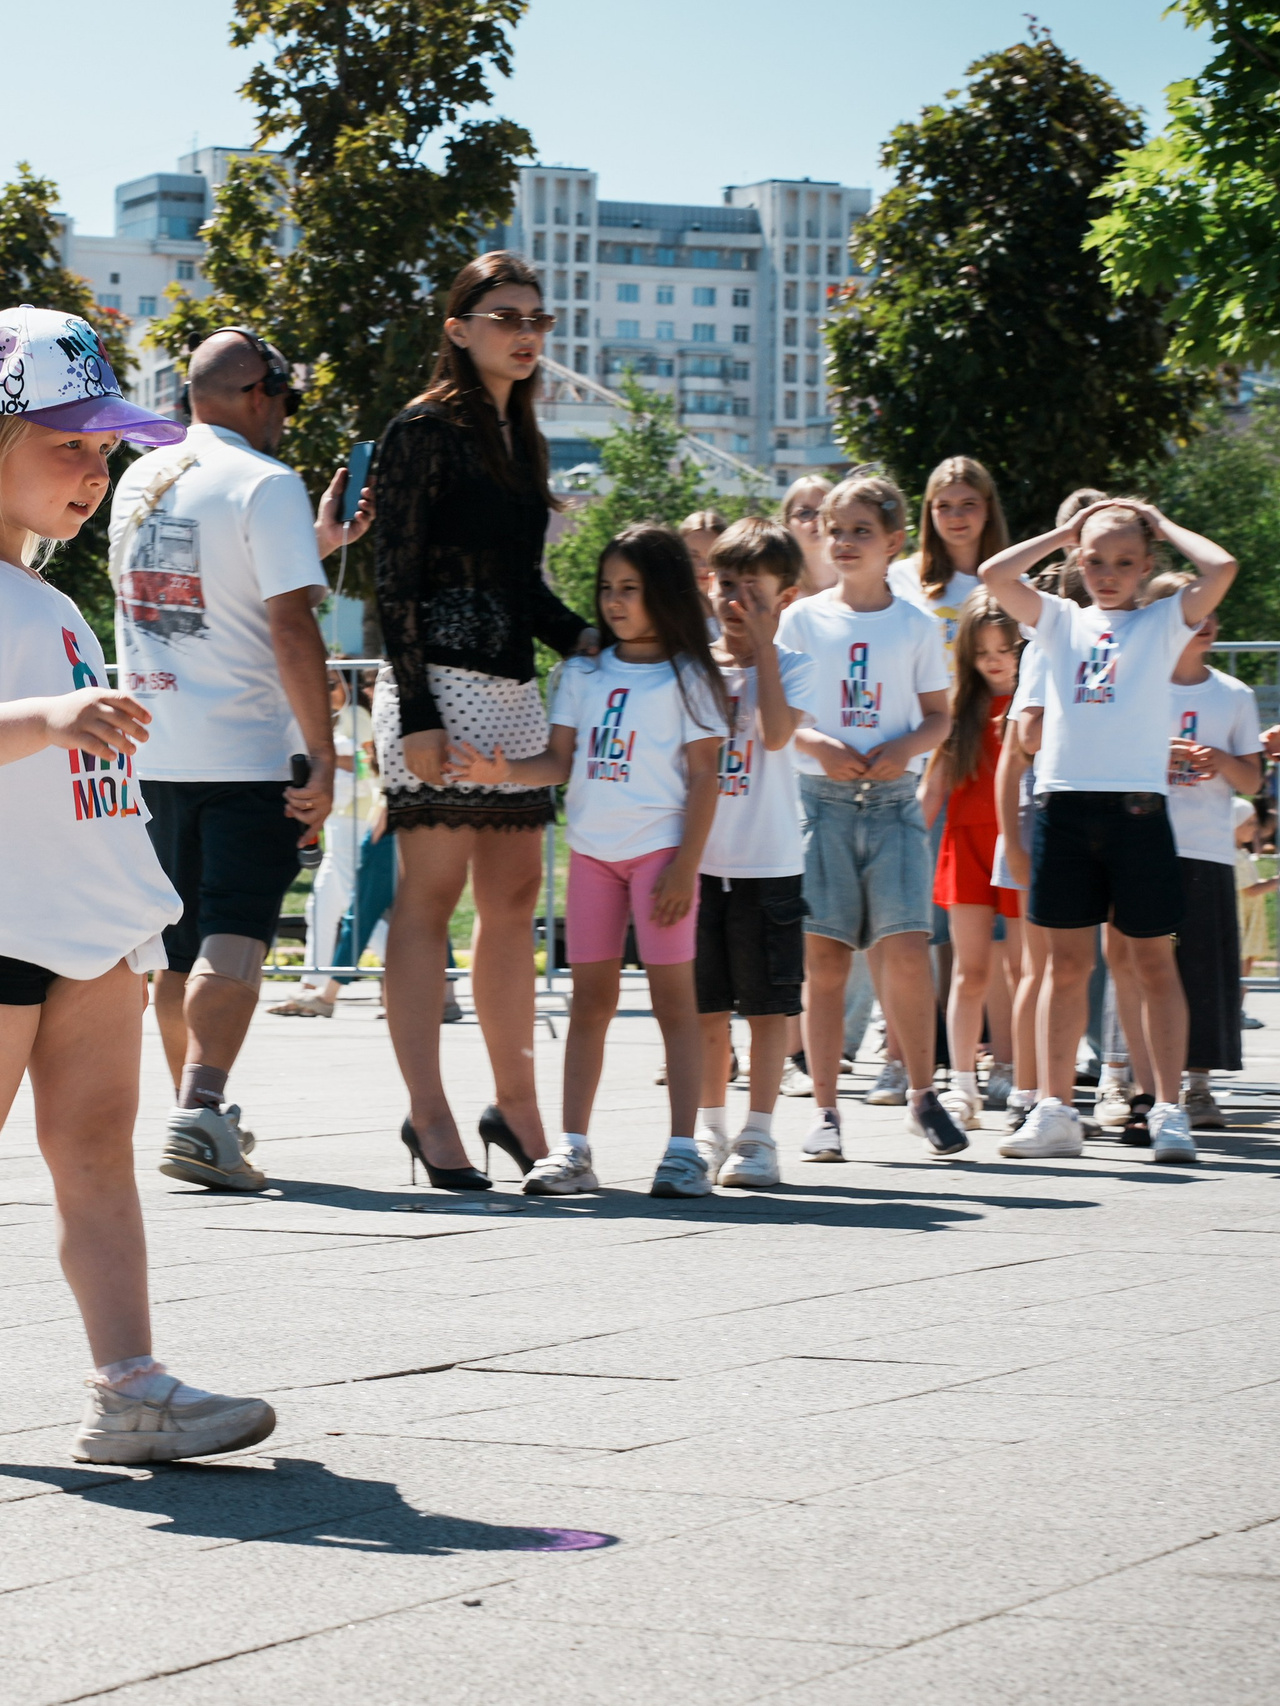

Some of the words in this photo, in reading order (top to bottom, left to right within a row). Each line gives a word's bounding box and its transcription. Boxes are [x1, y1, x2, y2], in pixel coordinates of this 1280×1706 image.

[849, 642, 869, 680] Я
[601, 687, 630, 727] Я
[841, 679, 882, 711] МЫ
[587, 727, 636, 762] МЫ
[717, 739, 754, 774] Ы
[586, 760, 631, 783] МОДА
[717, 775, 751, 797] ОДА
[72, 775, 142, 821] МОД
